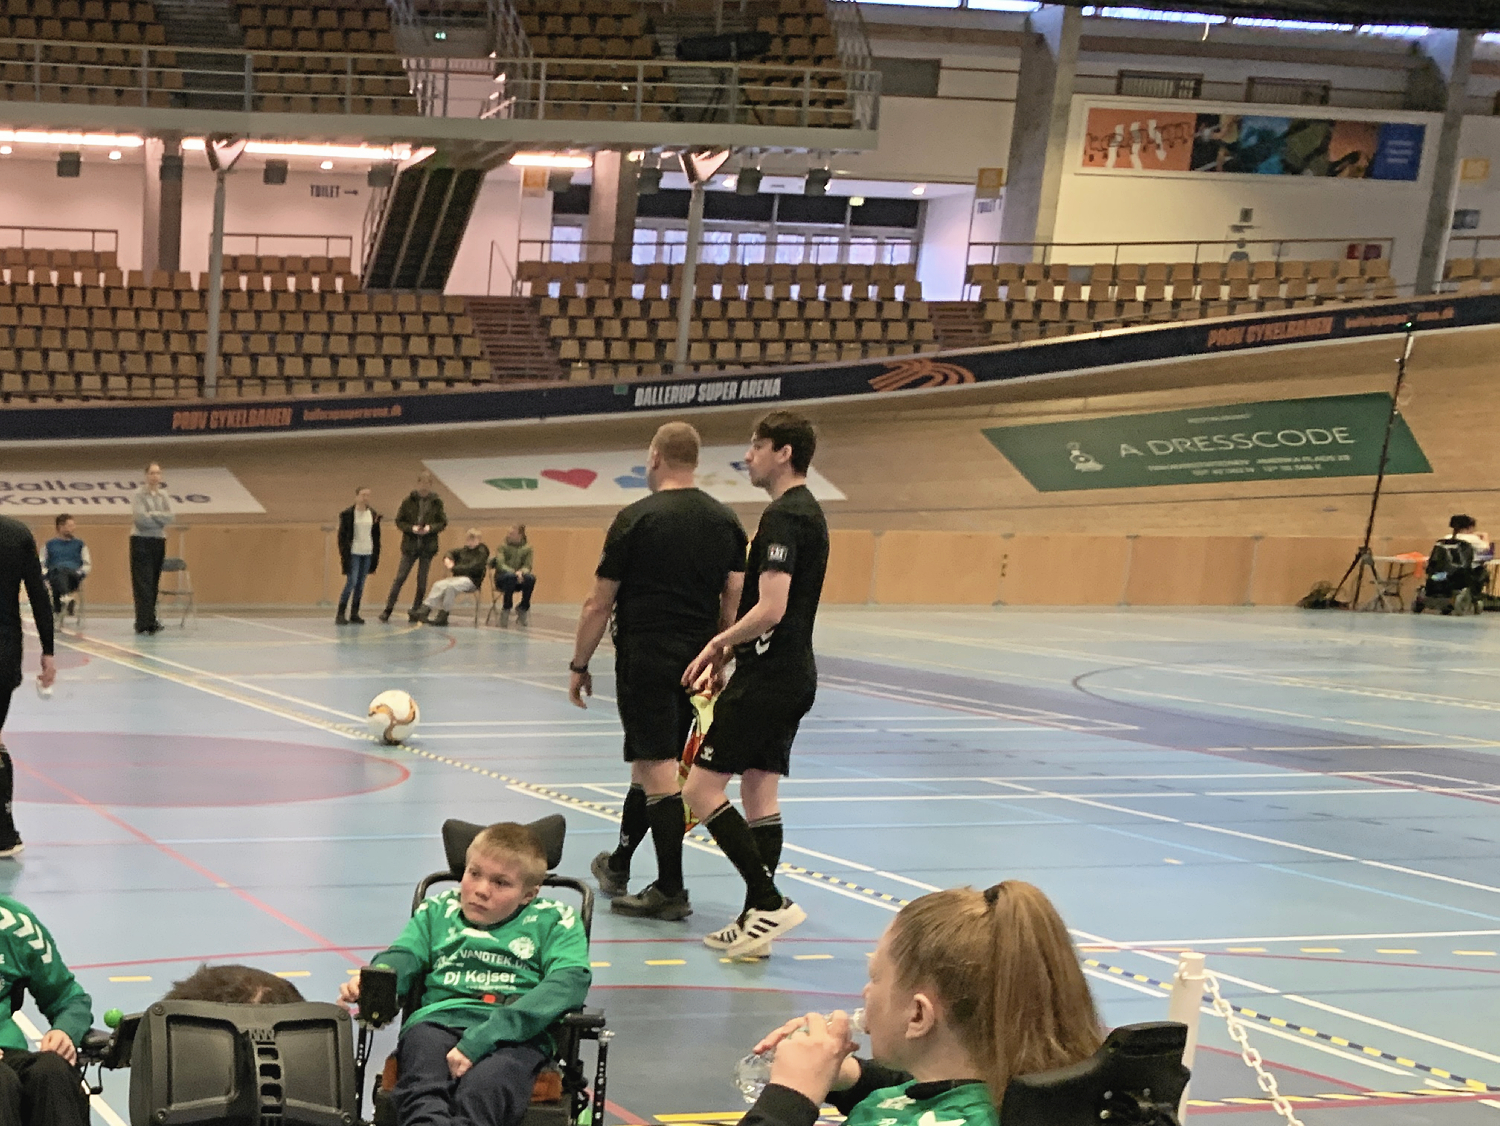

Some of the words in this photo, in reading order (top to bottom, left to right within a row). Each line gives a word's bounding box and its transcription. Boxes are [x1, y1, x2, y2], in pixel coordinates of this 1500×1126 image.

[634, 384, 697, 407] BALLERUP
[697, 382, 739, 402] SUPER
[739, 377, 781, 399] ARENA
[1120, 443, 1145, 458] A
[1146, 426, 1356, 456] DRESSCODE
[443, 970, 461, 986] Dj
[465, 970, 517, 986] Kejser
